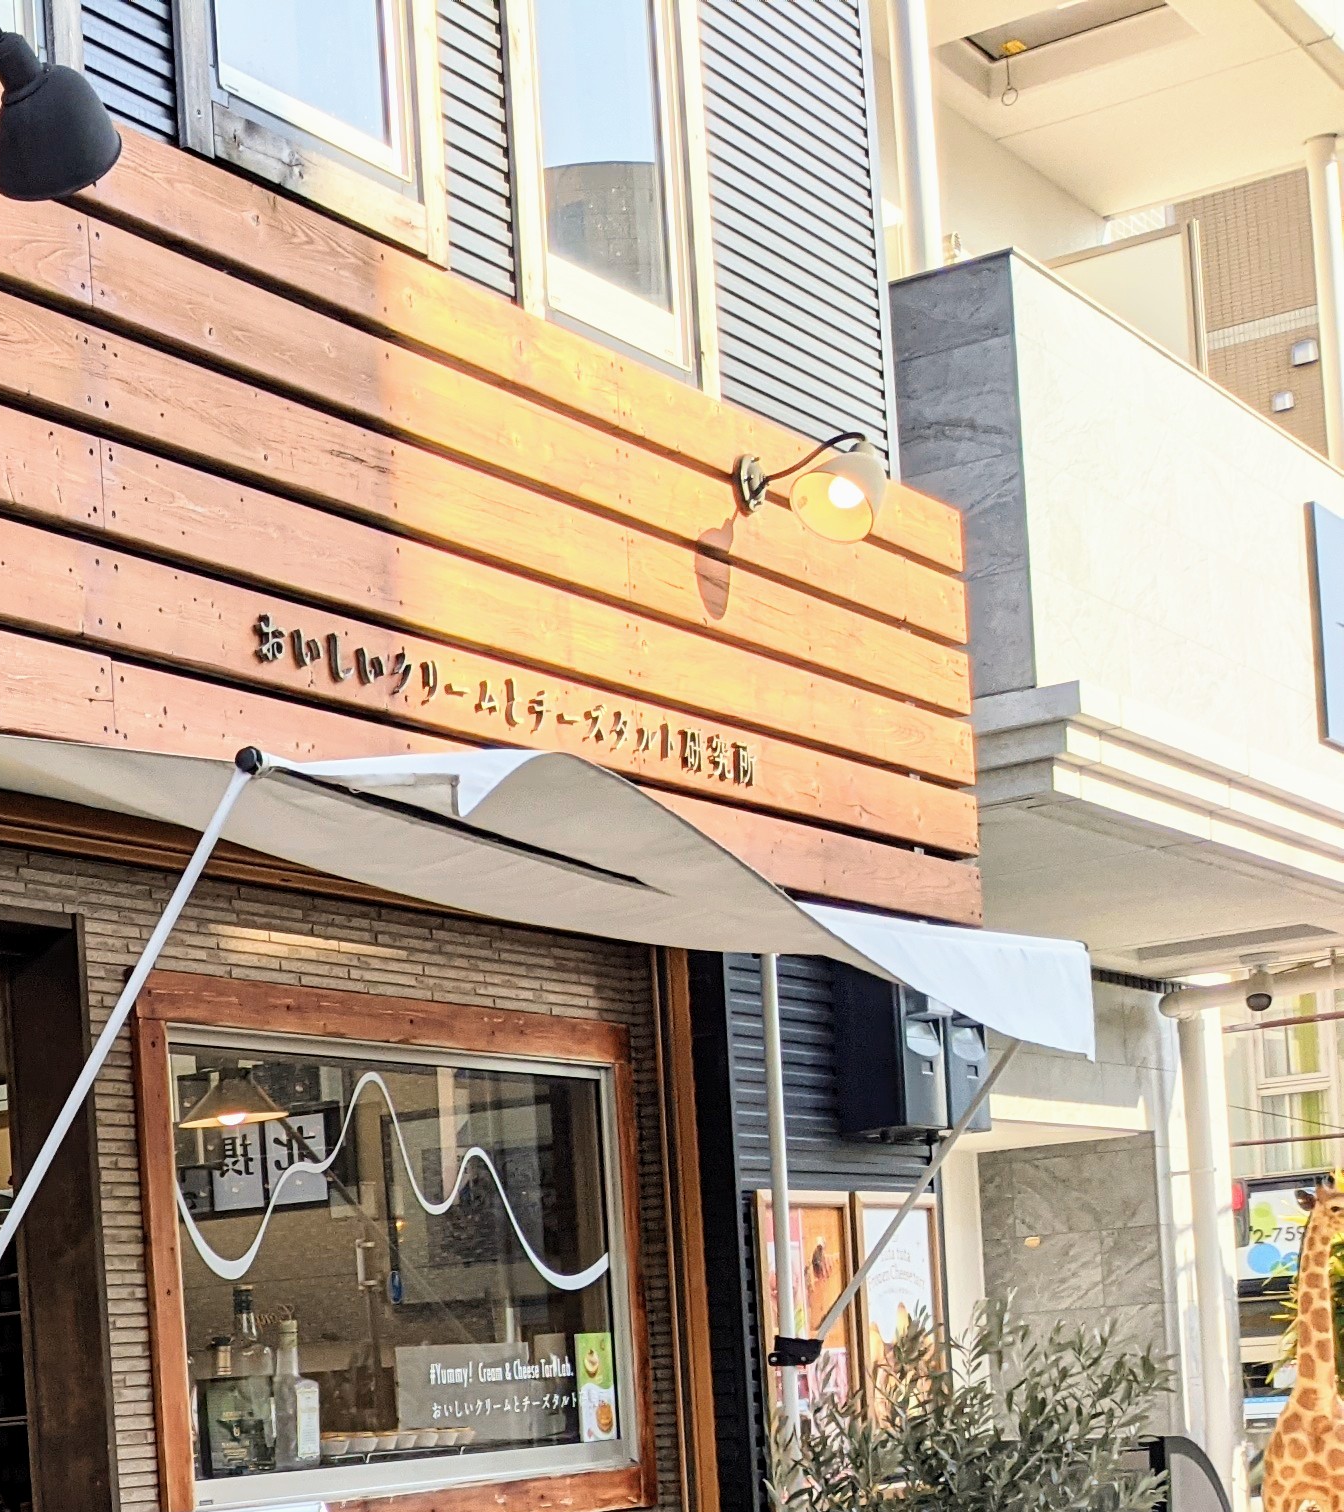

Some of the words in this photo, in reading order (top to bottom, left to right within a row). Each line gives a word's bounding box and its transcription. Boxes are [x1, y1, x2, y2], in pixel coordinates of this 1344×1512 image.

[430, 1361, 473, 1388] #Yummy!
[478, 1362, 503, 1382] Cream
[505, 1363, 512, 1380] &
[513, 1360, 539, 1381] Cheese
[557, 1355, 574, 1377] Lab.
[432, 1389, 584, 1420] おいしいクリームとチーズタルト
